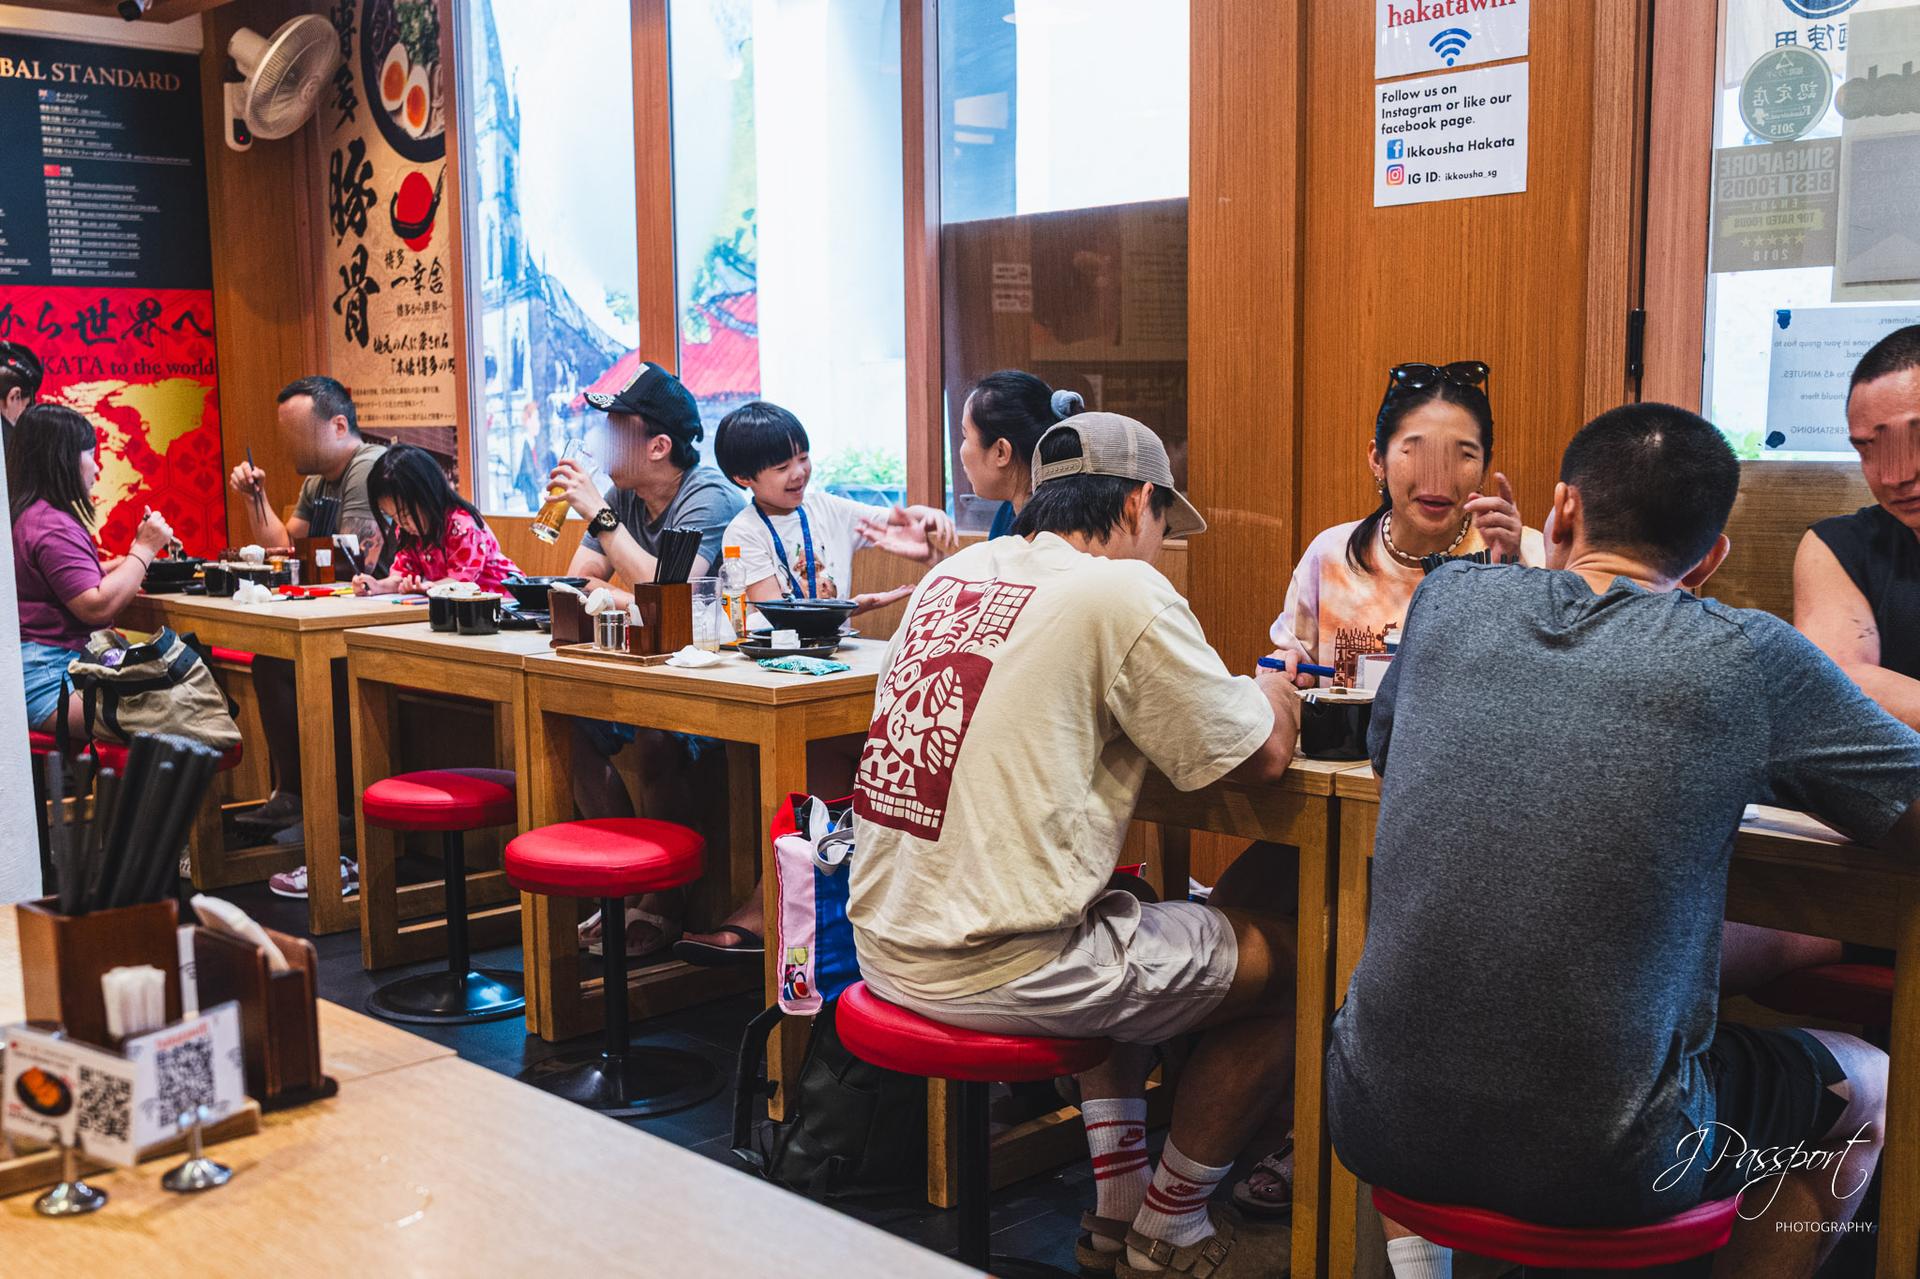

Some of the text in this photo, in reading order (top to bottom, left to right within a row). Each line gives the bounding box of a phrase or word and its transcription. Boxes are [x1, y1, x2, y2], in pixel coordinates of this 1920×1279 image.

[1387, 0, 1517, 28] hakataw
[52, 63, 181, 92] STANDARD
[1382, 85, 1457, 103] Follow us on
[1382, 94, 1512, 119] Instagram or like our
[1381, 116, 1476, 134] facebook page.
[1407, 142, 1464, 158] Ikkousha
[1468, 137, 1515, 151] Hakata
[1408, 169, 1498, 184] IG ID: ikkousha_sg
[41, 356, 104, 376] KATA
[111, 361, 128, 376] to
[134, 358, 162, 376] the
[166, 357, 215, 376] world
